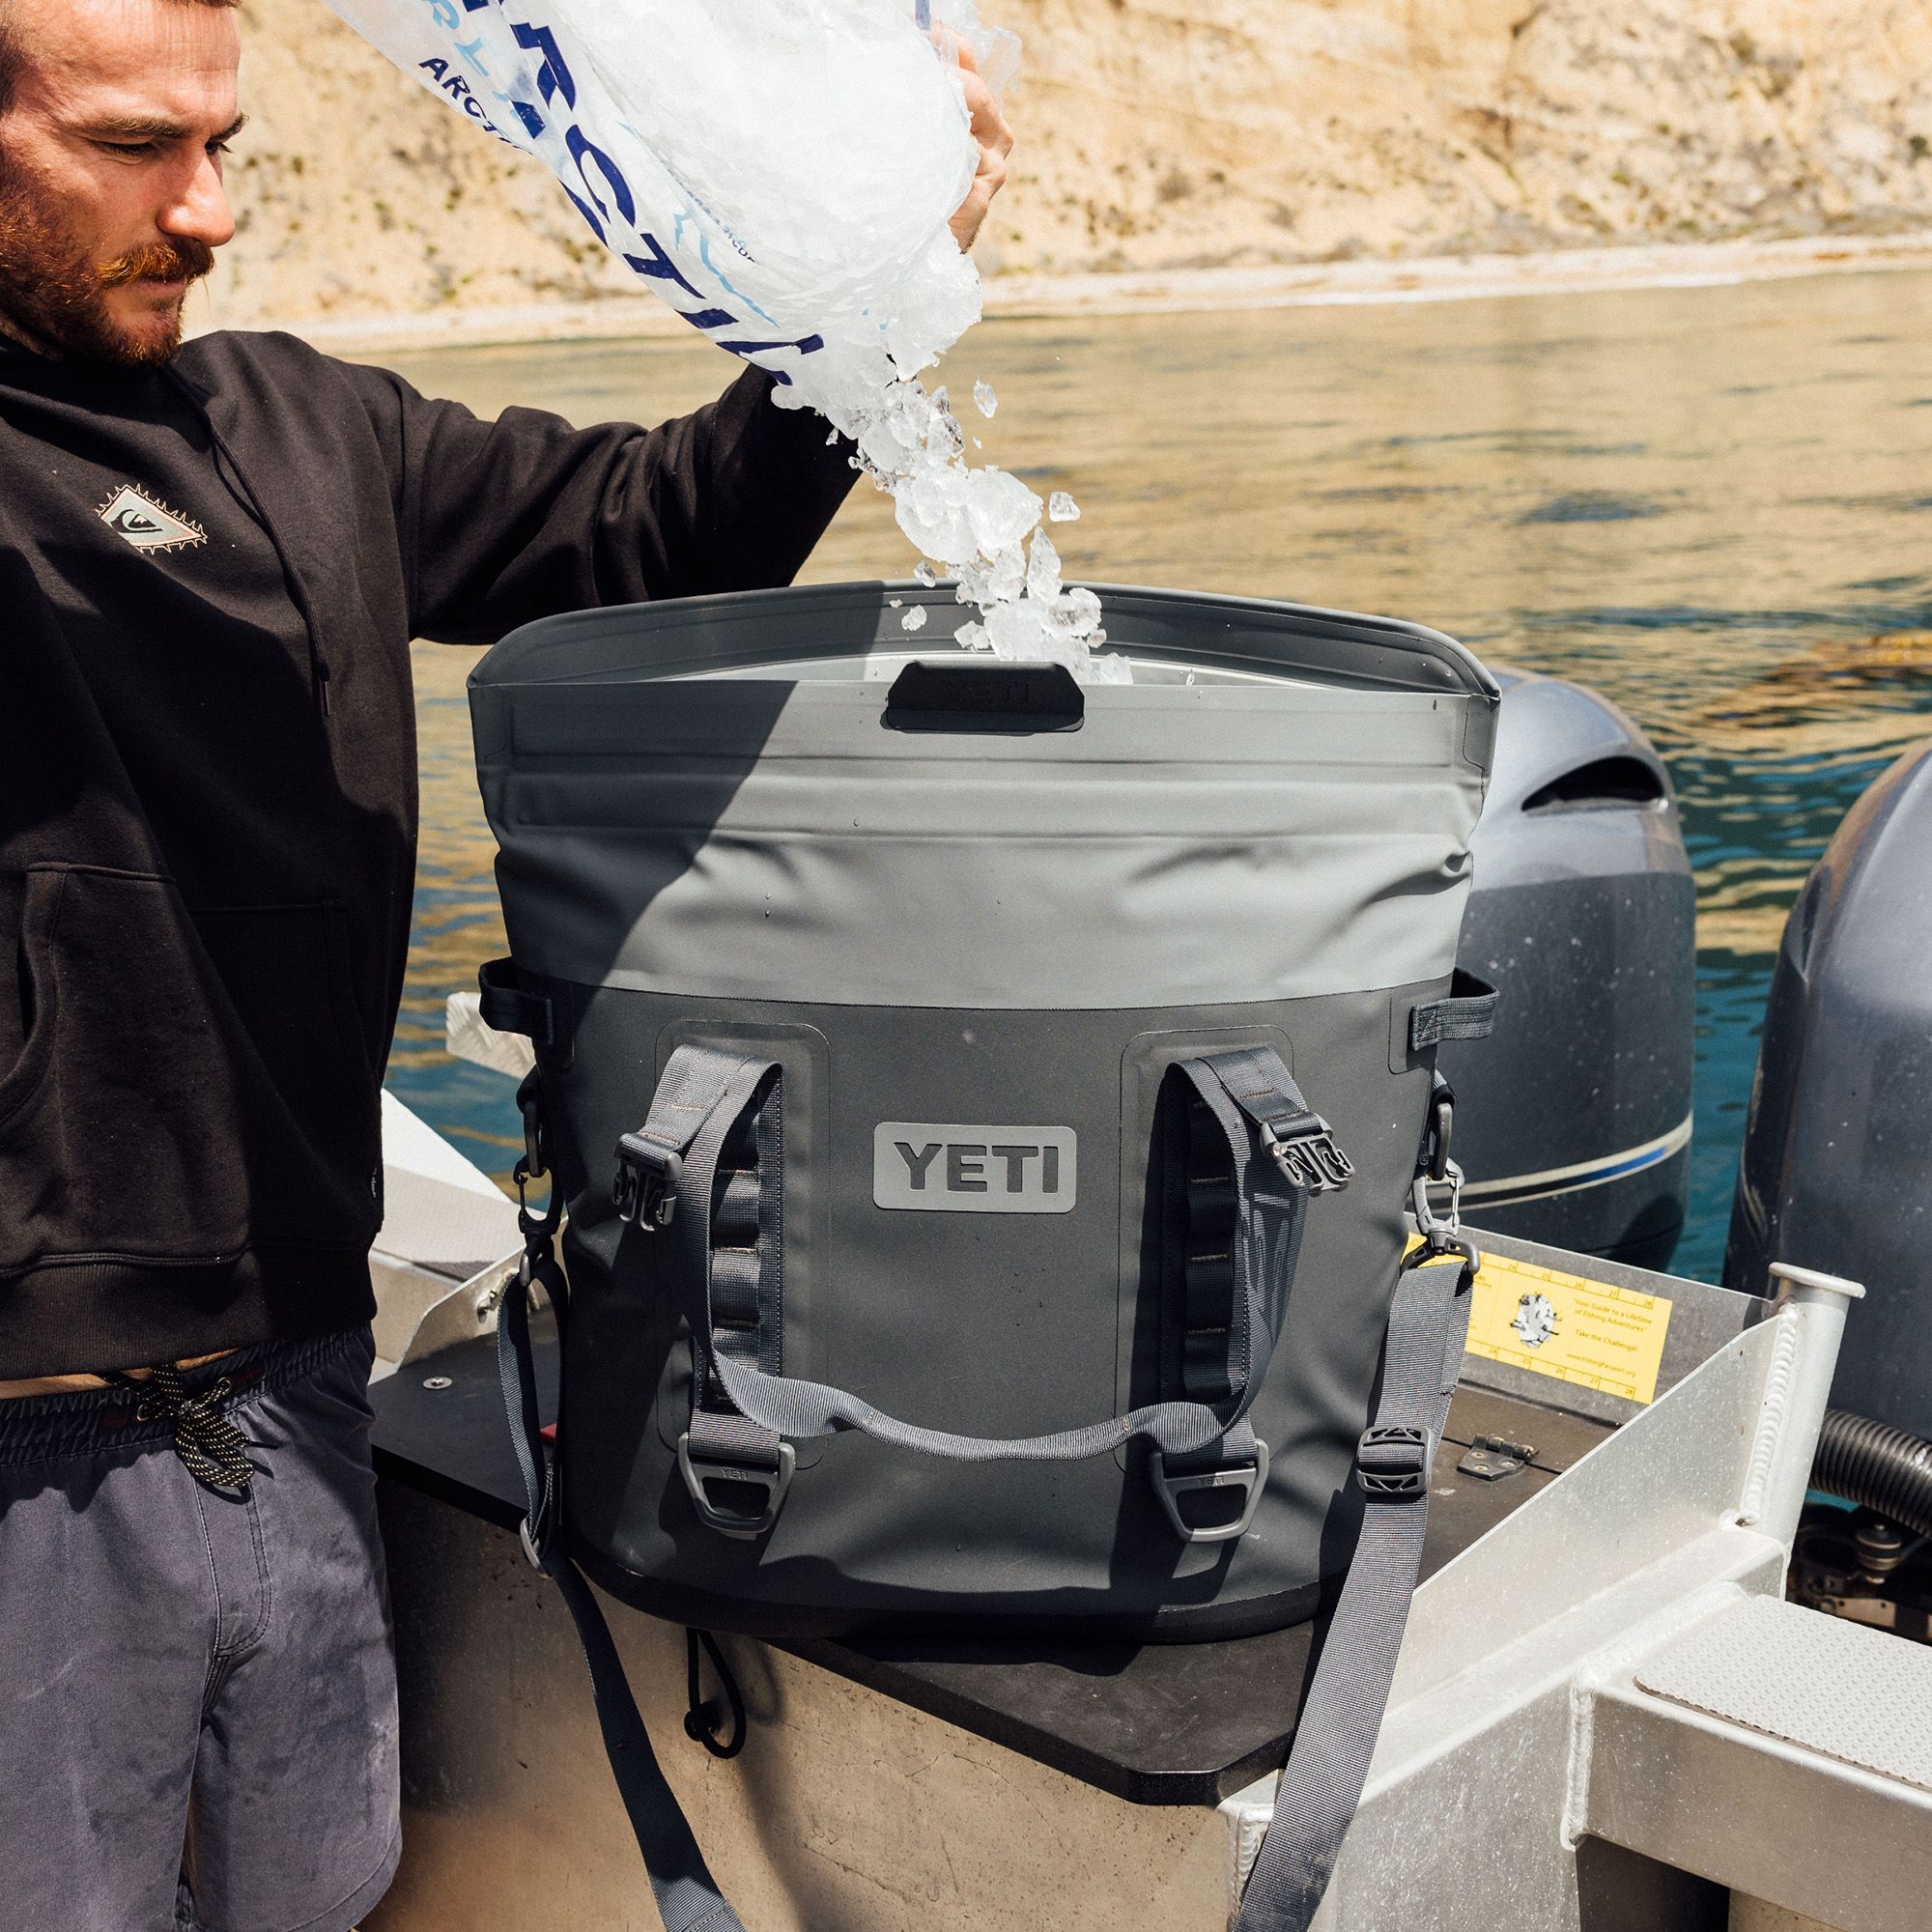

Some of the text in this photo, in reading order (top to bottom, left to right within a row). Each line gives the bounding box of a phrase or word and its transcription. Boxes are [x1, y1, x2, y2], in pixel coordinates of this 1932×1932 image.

[946, 679, 1031, 704] YETI
[893, 1142, 1059, 1194] YETI
[1576, 1328, 1589, 1338] Take
[1591, 1333, 1602, 1342] the
[721, 1467, 749, 1480] YETI
[1197, 1475, 1225, 1487] YETI
